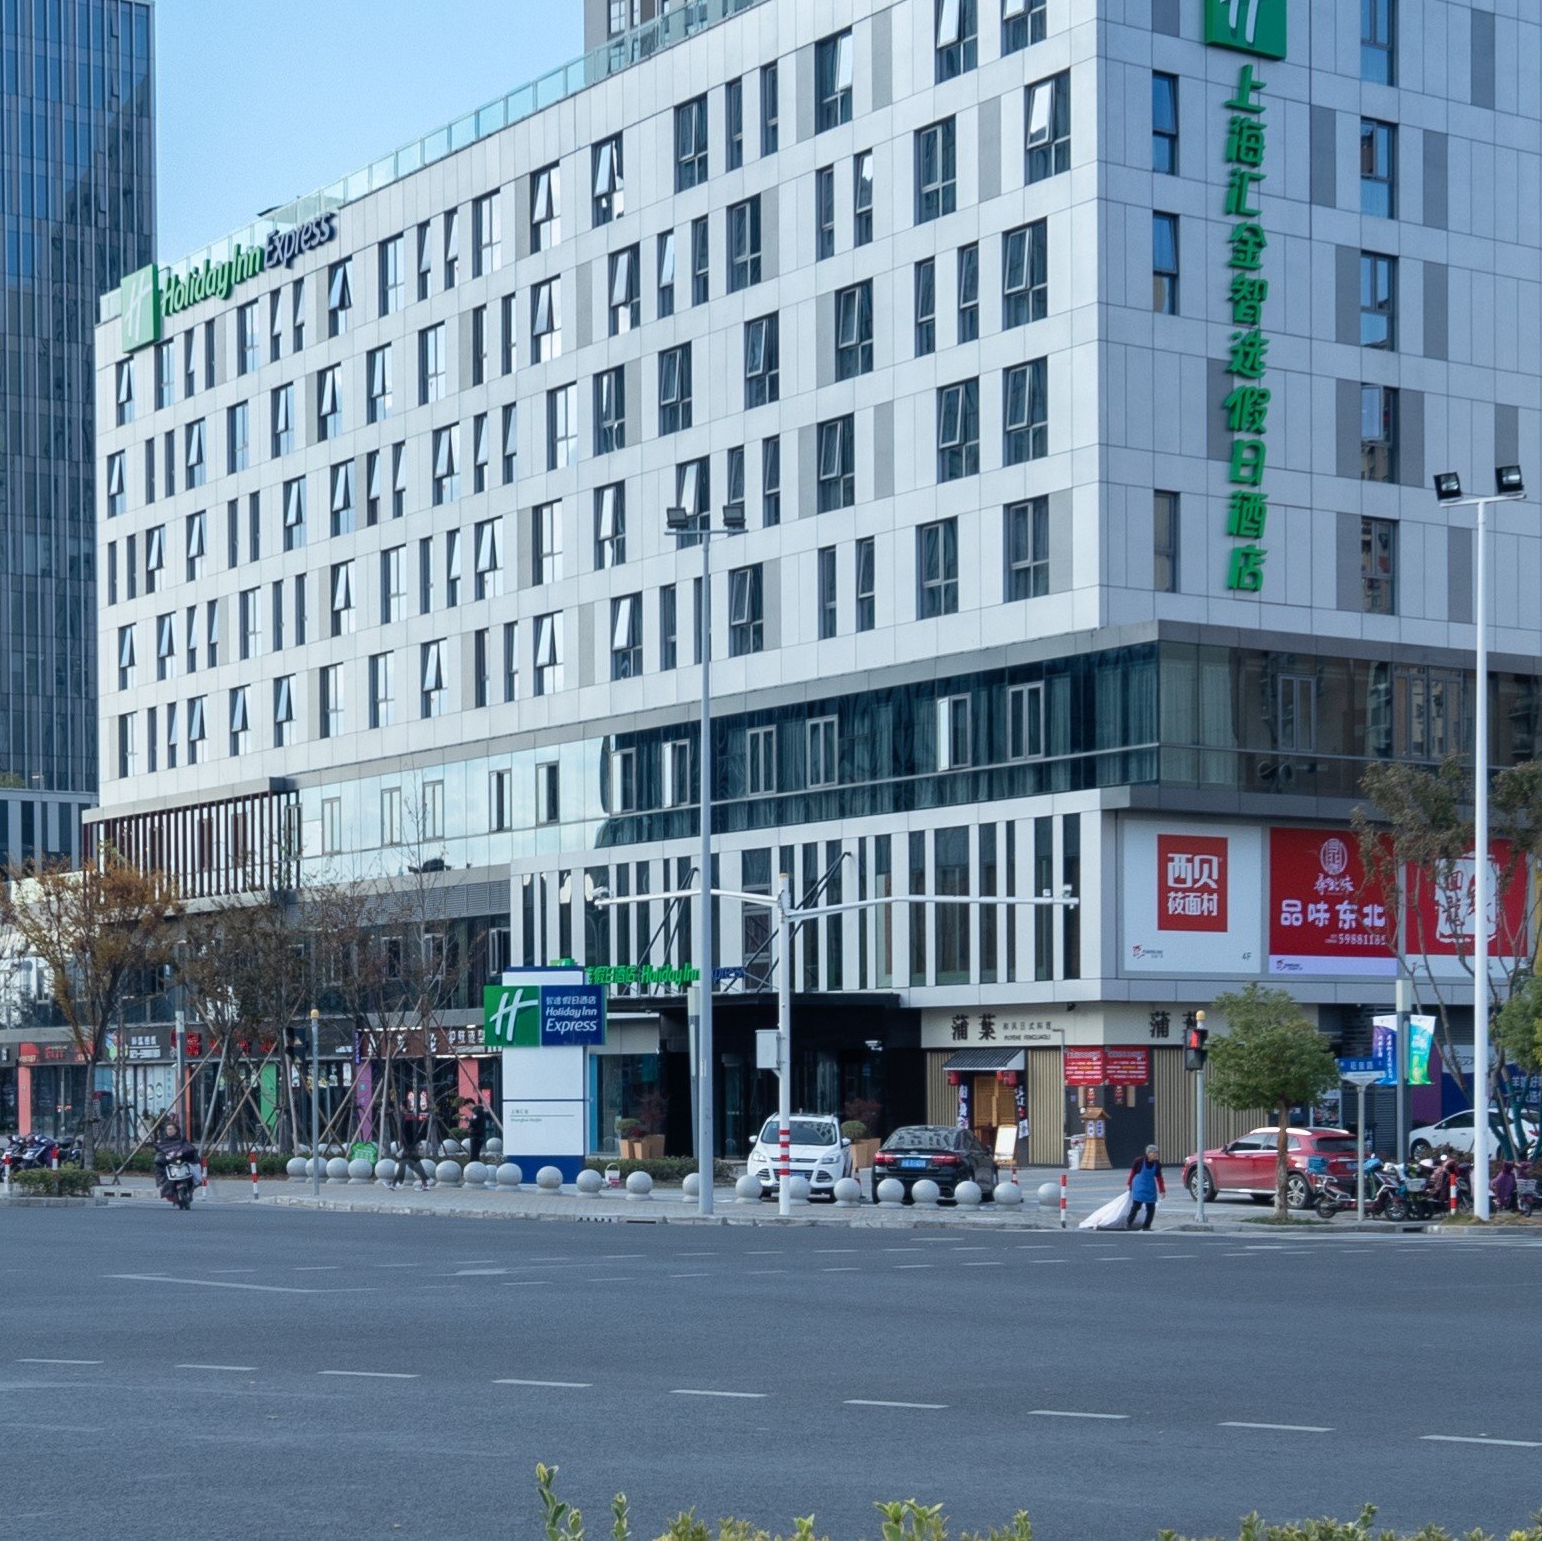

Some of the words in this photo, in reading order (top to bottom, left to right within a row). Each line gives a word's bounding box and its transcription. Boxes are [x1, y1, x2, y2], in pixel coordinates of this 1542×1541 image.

[160, 259, 232, 316] Holiday
[232, 244, 265, 285] Inn
[264, 212, 337, 269] Express
[1222, 63, 1269, 593] 上海汇金智选假日酒店
[1167, 853, 1219, 889] 西贝
[1167, 891, 1219, 916] 莜面村
[1280, 899, 1386, 930] 品味东北
[545, 1006, 581, 1018] Holiday
[582, 1006, 597, 1016] Inn
[545, 1018, 597, 1035] Express
